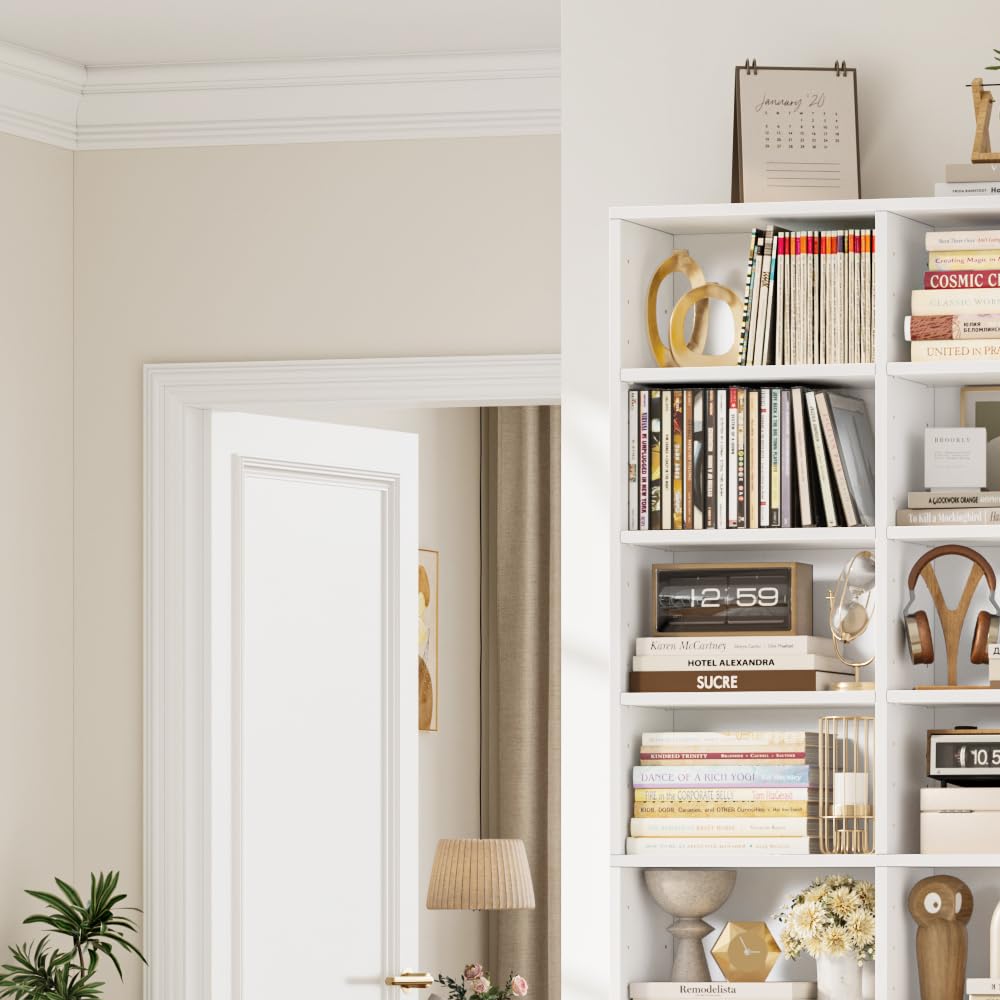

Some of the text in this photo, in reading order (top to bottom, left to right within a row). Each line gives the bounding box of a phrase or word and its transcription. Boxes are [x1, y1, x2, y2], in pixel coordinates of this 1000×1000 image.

[930, 274, 984, 288] COSMIC
[927, 346, 970, 356] UNITED
[972, 347, 981, 356] IN
[691, 587, 779, 607] 12 59
[650, 641, 676, 650] Karen
[679, 640, 727, 651] McCartney
[719, 659, 775, 667] ALEXANDRA
[697, 675, 738, 689] SUCRE
[641, 773, 674, 782] DANCE
[694, 773, 701, 781] A
[731, 772, 755, 782] YOGI
[679, 985, 737, 994] Remodelista
